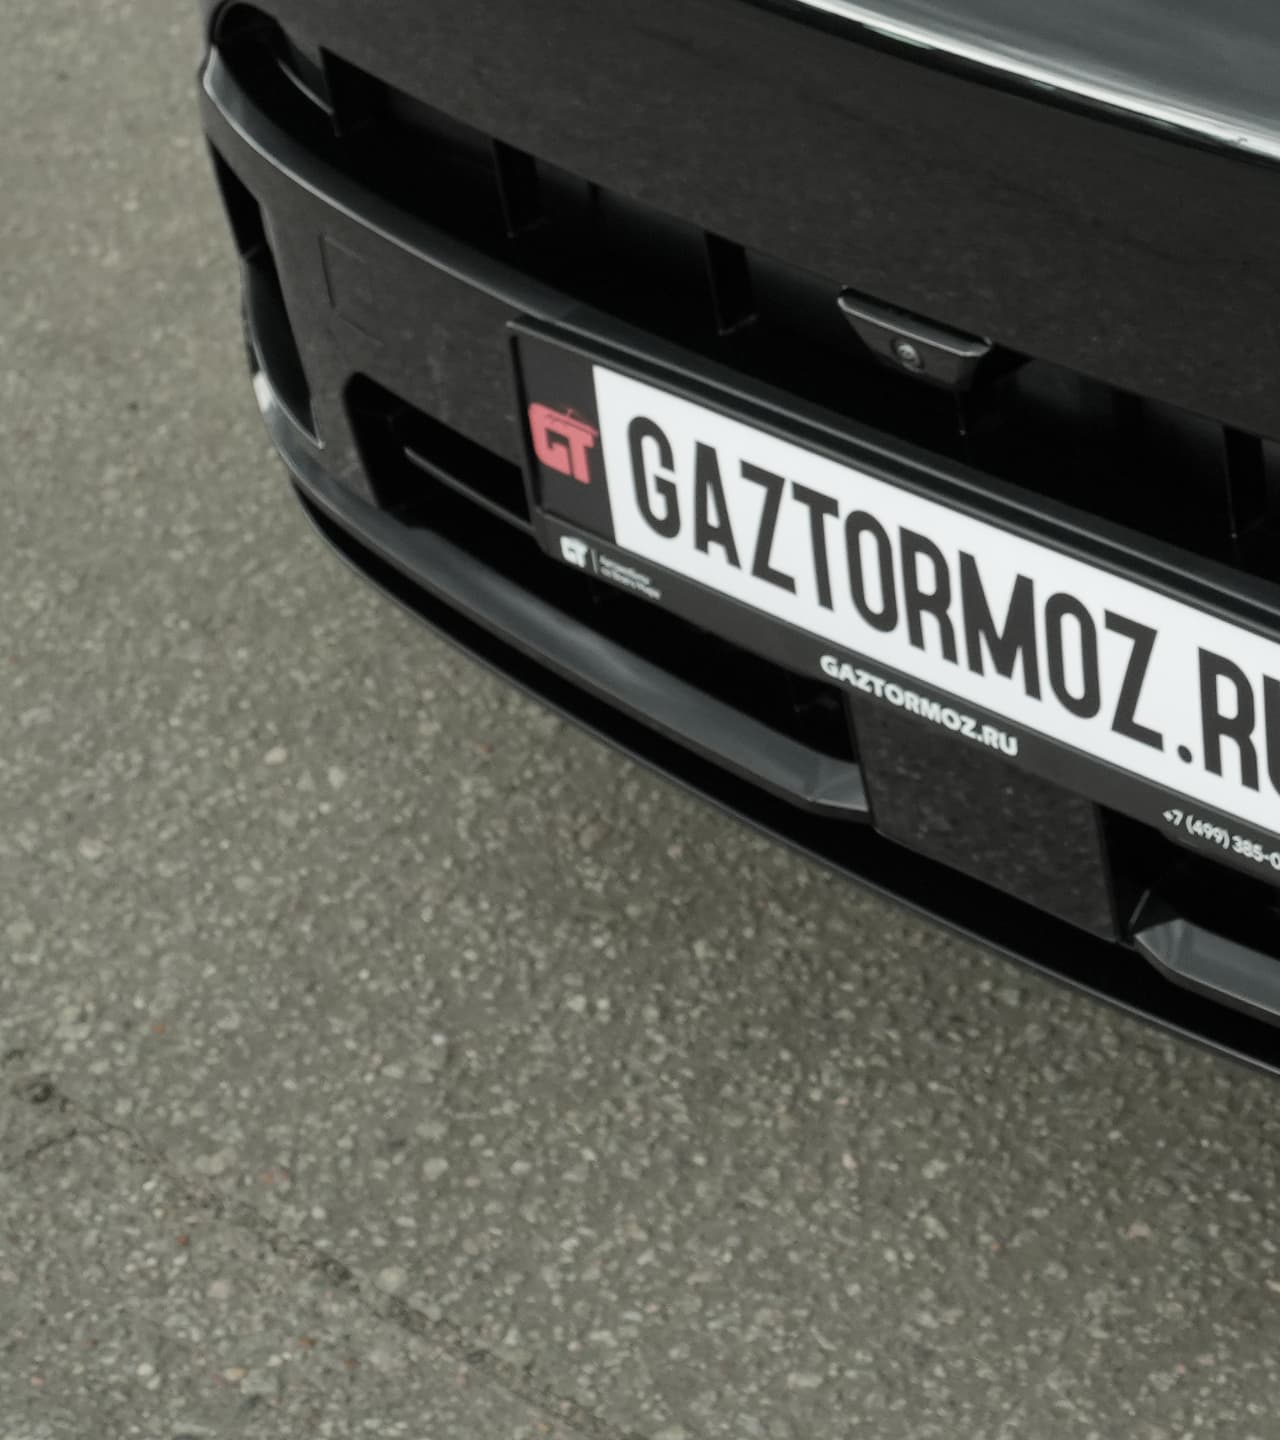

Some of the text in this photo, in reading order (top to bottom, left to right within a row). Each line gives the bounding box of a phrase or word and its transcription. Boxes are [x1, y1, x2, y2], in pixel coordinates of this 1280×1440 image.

[528, 402, 598, 485] GT
[820, 654, 1018, 756] GAZTORMOZ.RU
[1162, 809, 1184, 826] +7
[1185, 815, 1230, 849] (499)
